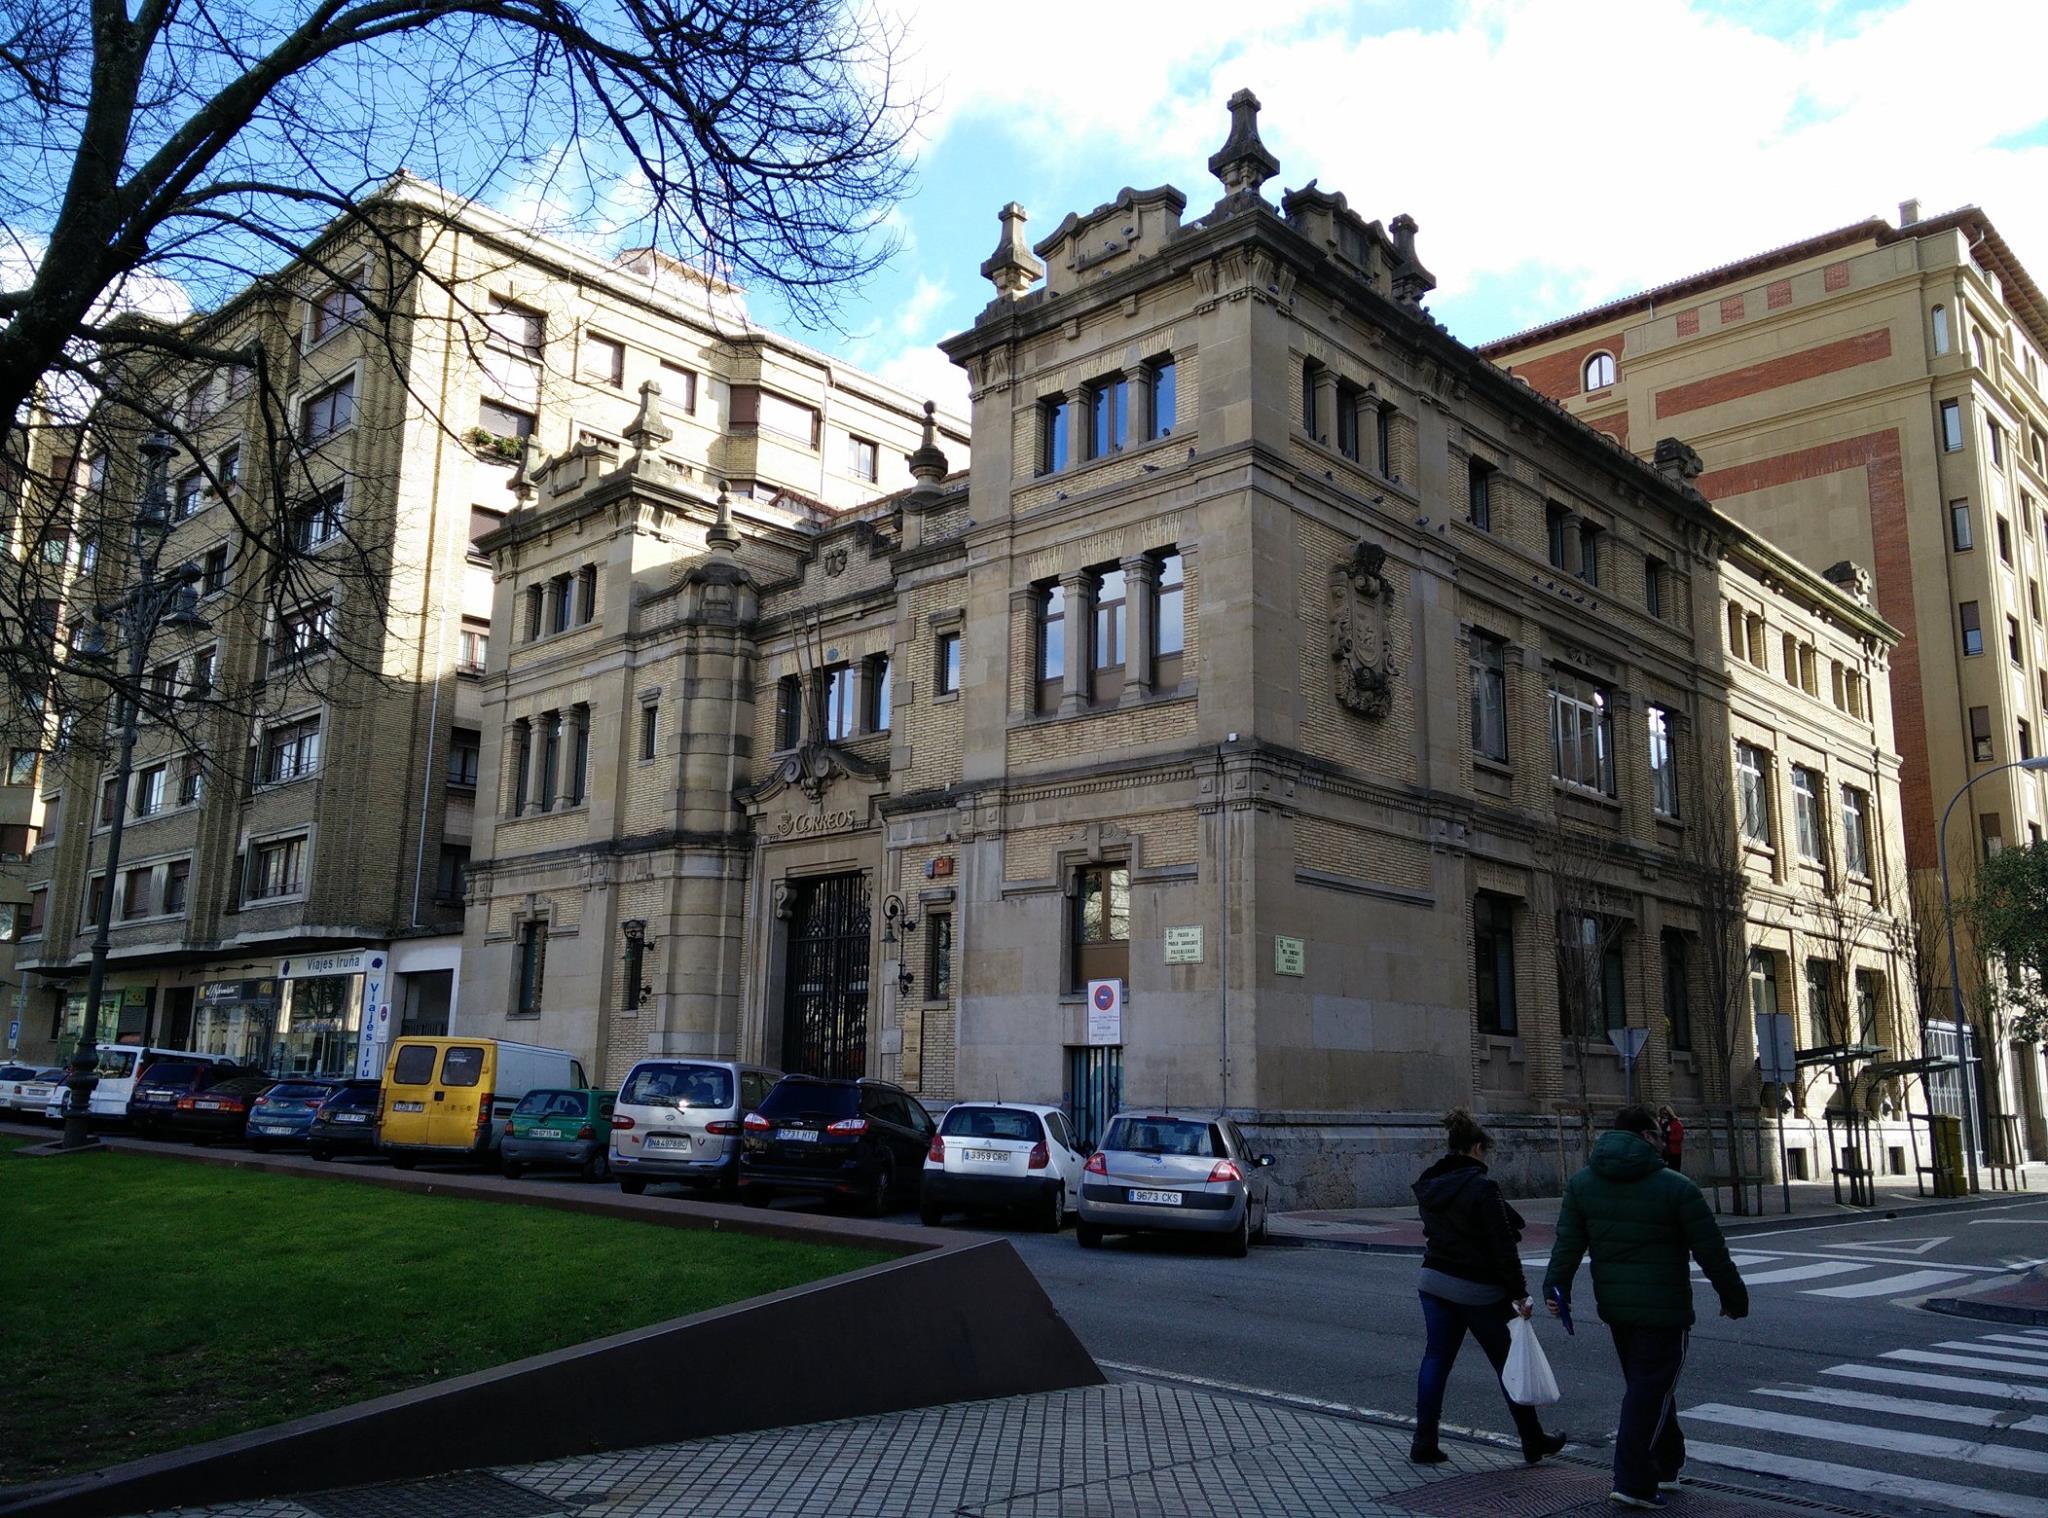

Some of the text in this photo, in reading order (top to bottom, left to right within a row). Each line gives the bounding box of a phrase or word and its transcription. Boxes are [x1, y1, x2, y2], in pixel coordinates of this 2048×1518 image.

[795, 810, 856, 833] CORREOS
[307, 955, 360, 972] Viajes Iruña
[971, 1152, 991, 1160] 3359
[1136, 1191, 1178, 1203] 9673 CKS
